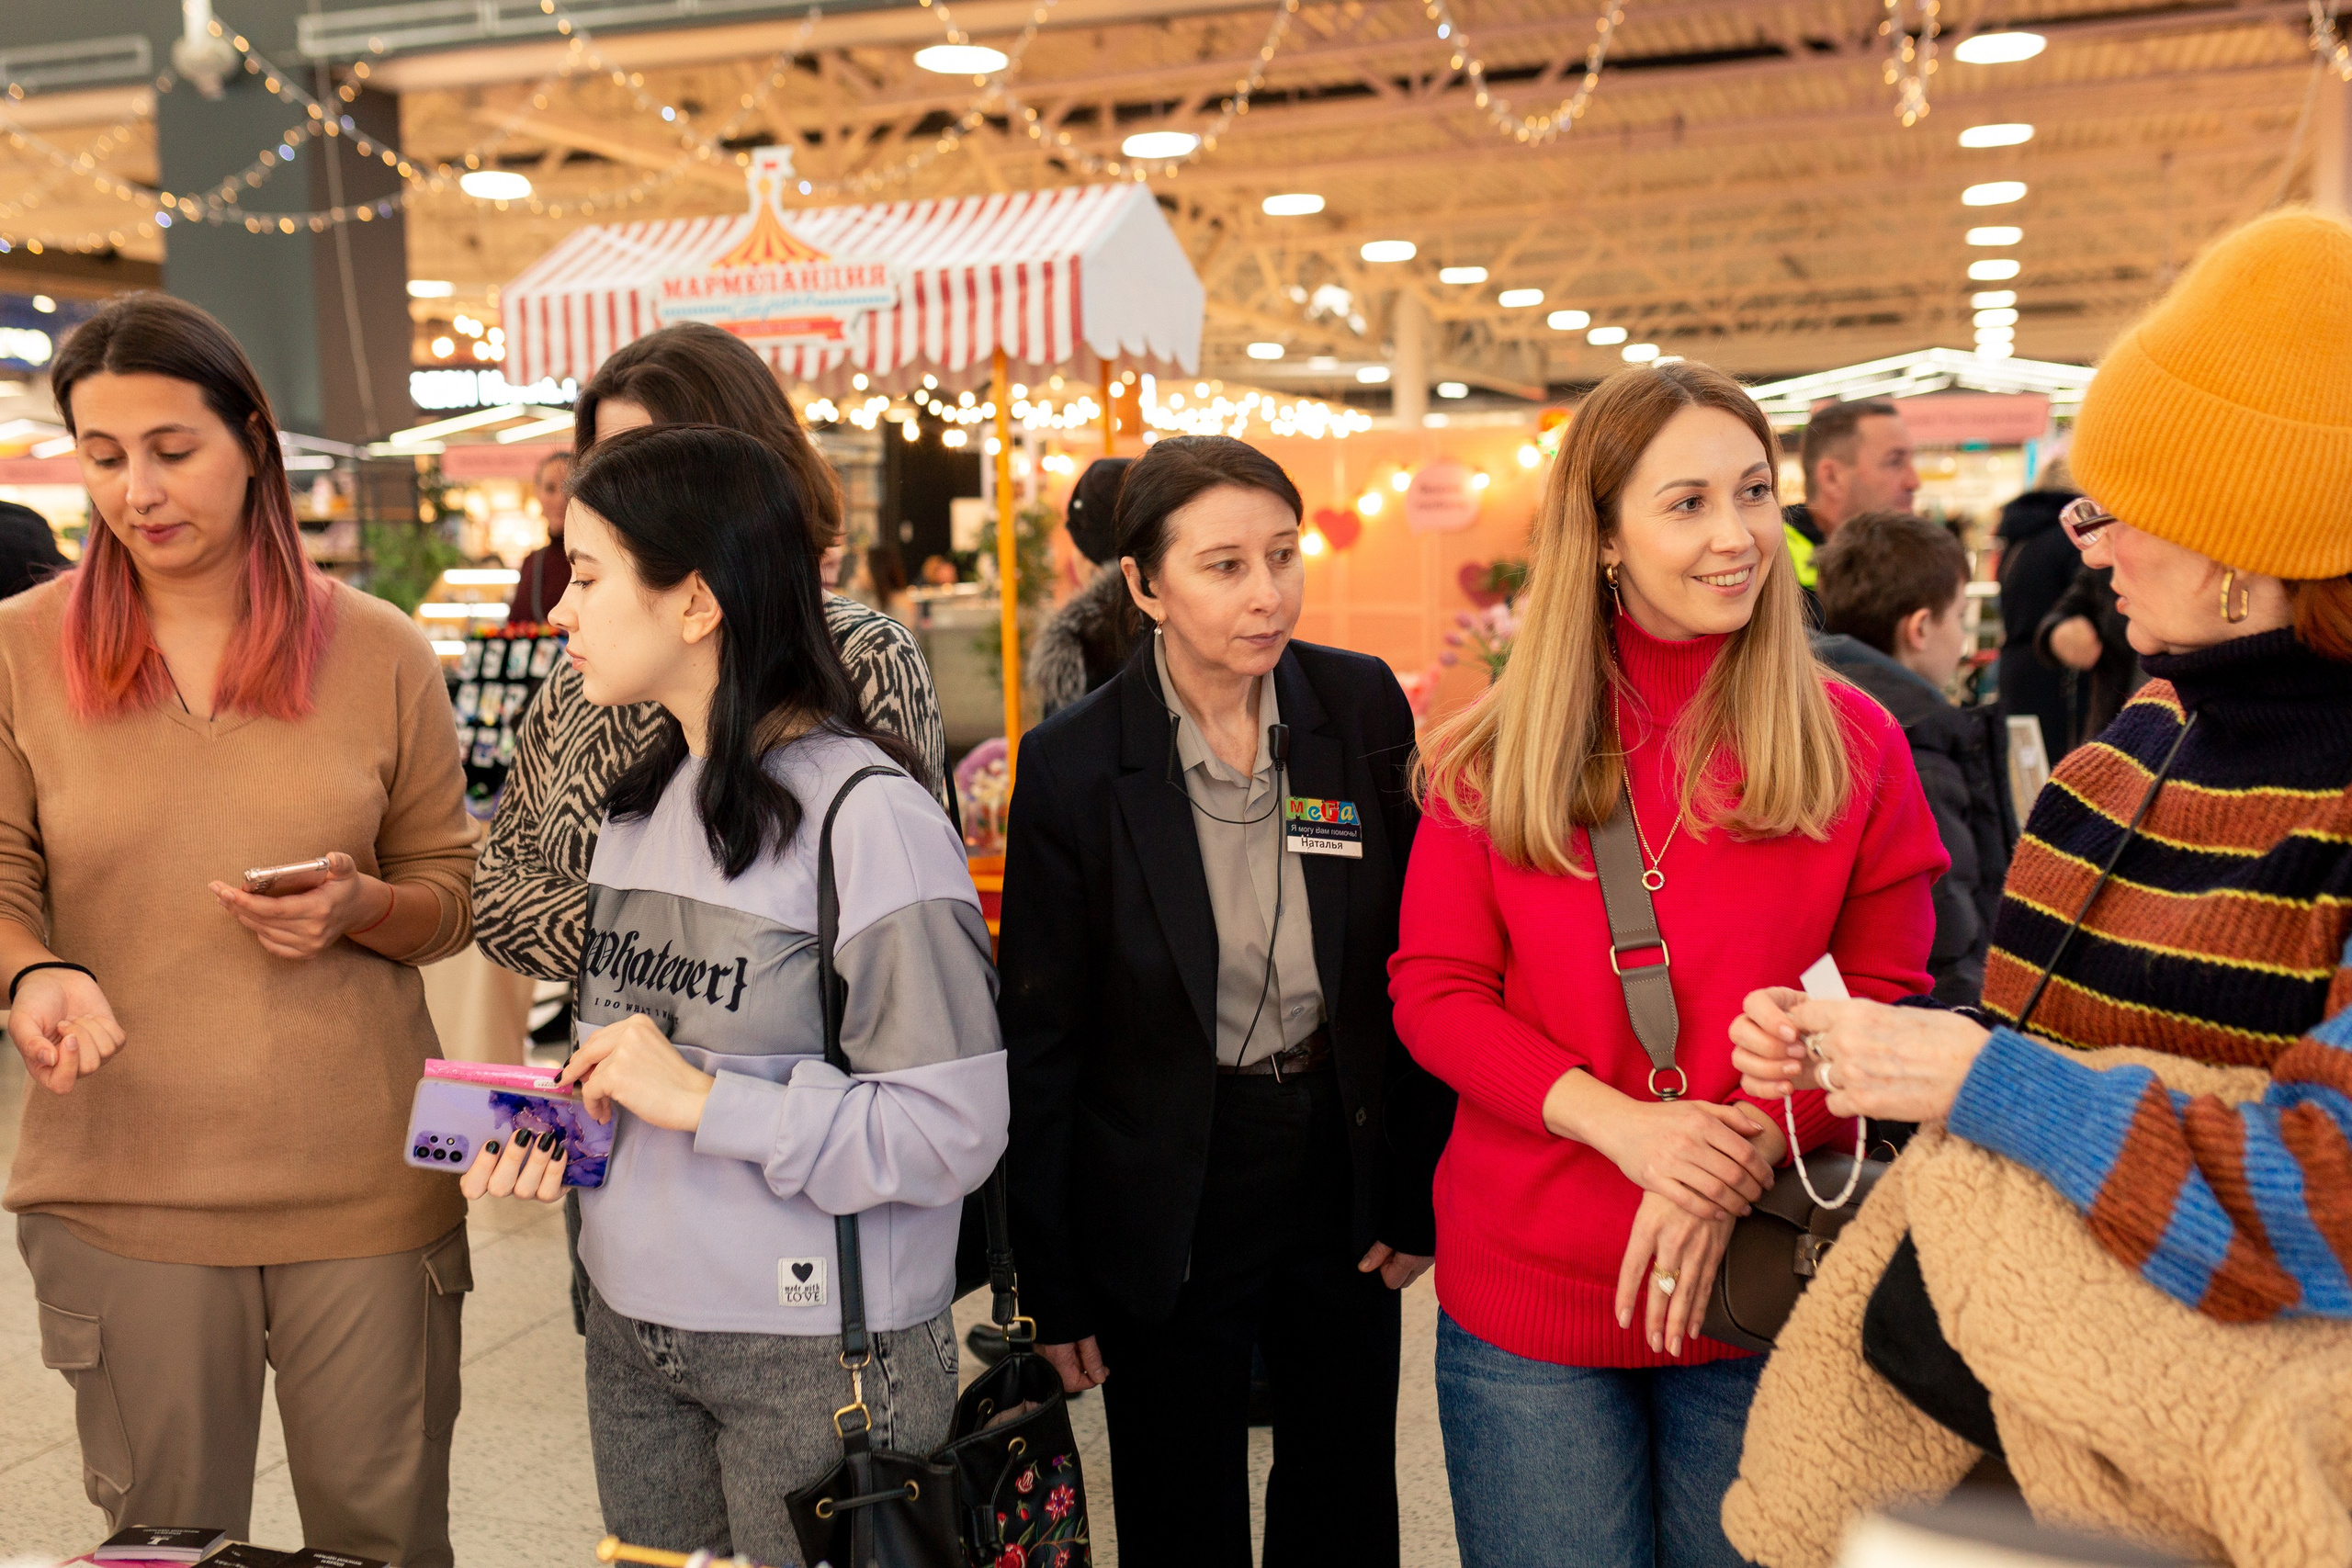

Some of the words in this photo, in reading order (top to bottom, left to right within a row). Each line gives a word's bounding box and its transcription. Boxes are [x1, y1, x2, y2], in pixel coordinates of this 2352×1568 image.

[662, 264, 887, 299] МАРМЕЛАНДИЯ
[1298, 826, 1315, 834] могу
[1330, 829, 1358, 838] помочь!
[1301, 837, 1343, 850] Наталья
[594, 998, 600, 1006] I
[604, 999, 620, 1009] DO
[626, 1003, 651, 1015] WHAT
[785, 1284, 801, 1292] made
[804, 1283, 820, 1292] with
[786, 1292, 820, 1303] LOVE
